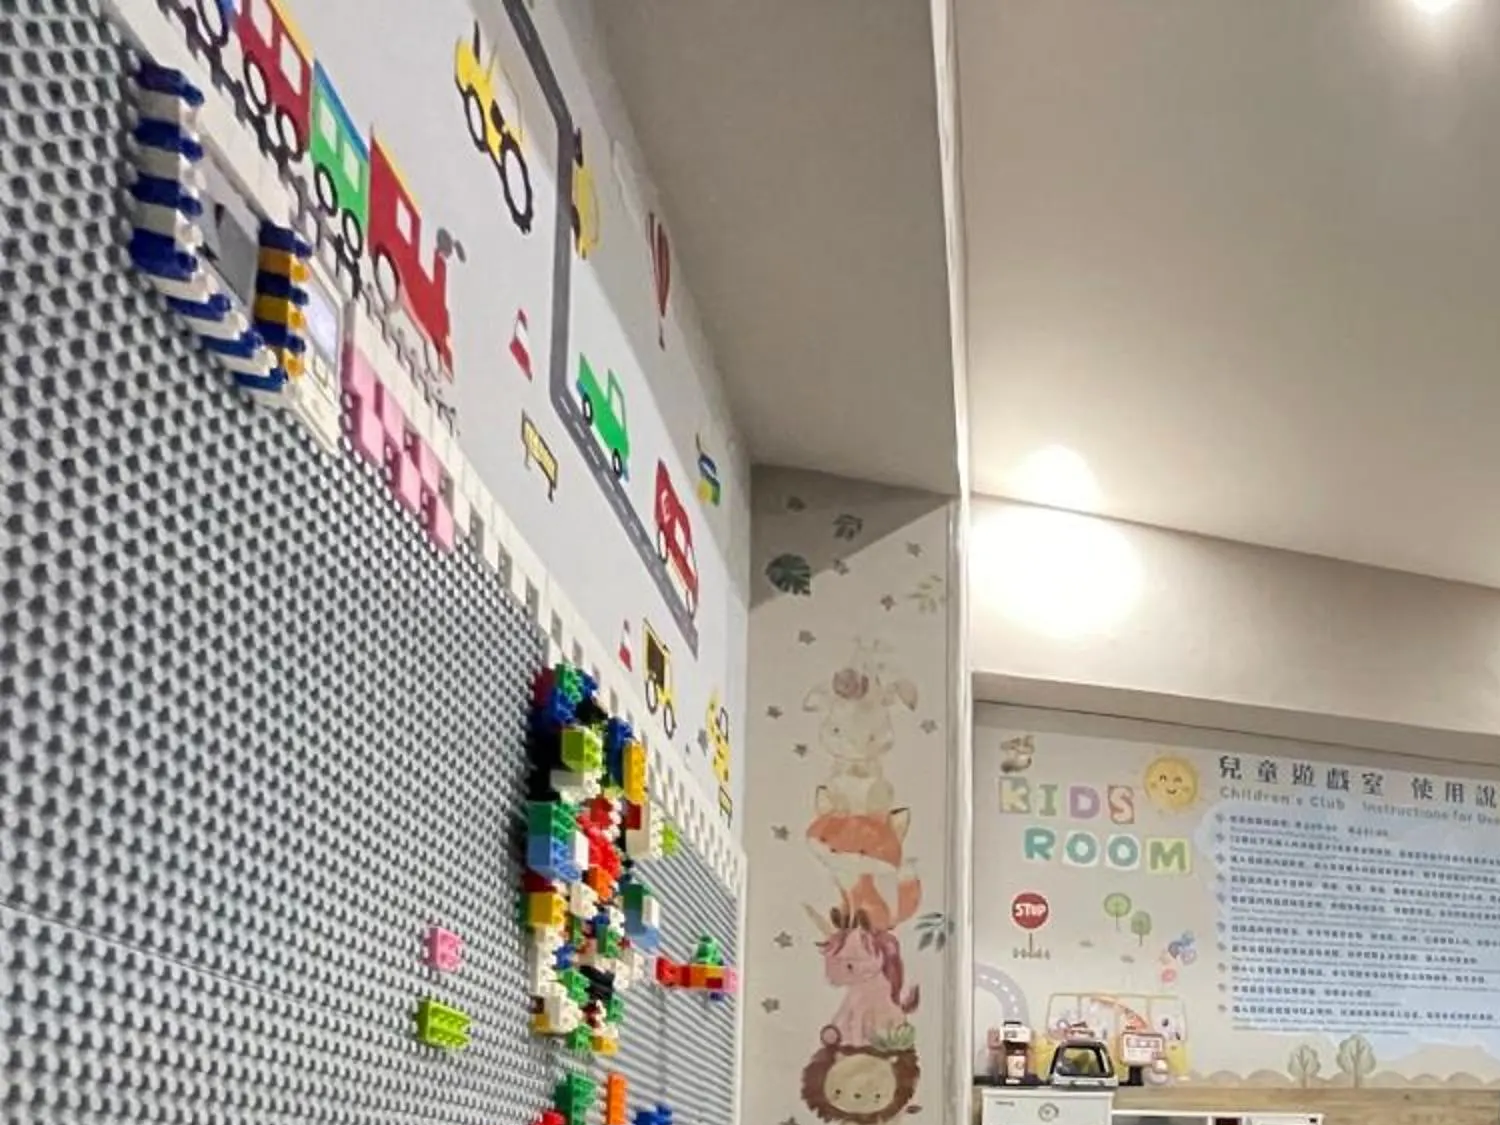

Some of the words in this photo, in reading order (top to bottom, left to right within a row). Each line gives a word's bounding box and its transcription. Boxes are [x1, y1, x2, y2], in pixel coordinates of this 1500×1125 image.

[1218, 755, 1385, 797] 兒童遊戲室
[999, 776, 1136, 825] KIDS
[1310, 795, 1346, 811] Club
[1362, 801, 1449, 821] Instructions
[1453, 809, 1473, 824] for
[1023, 826, 1188, 872] ROOM
[1015, 903, 1047, 917] STOP
